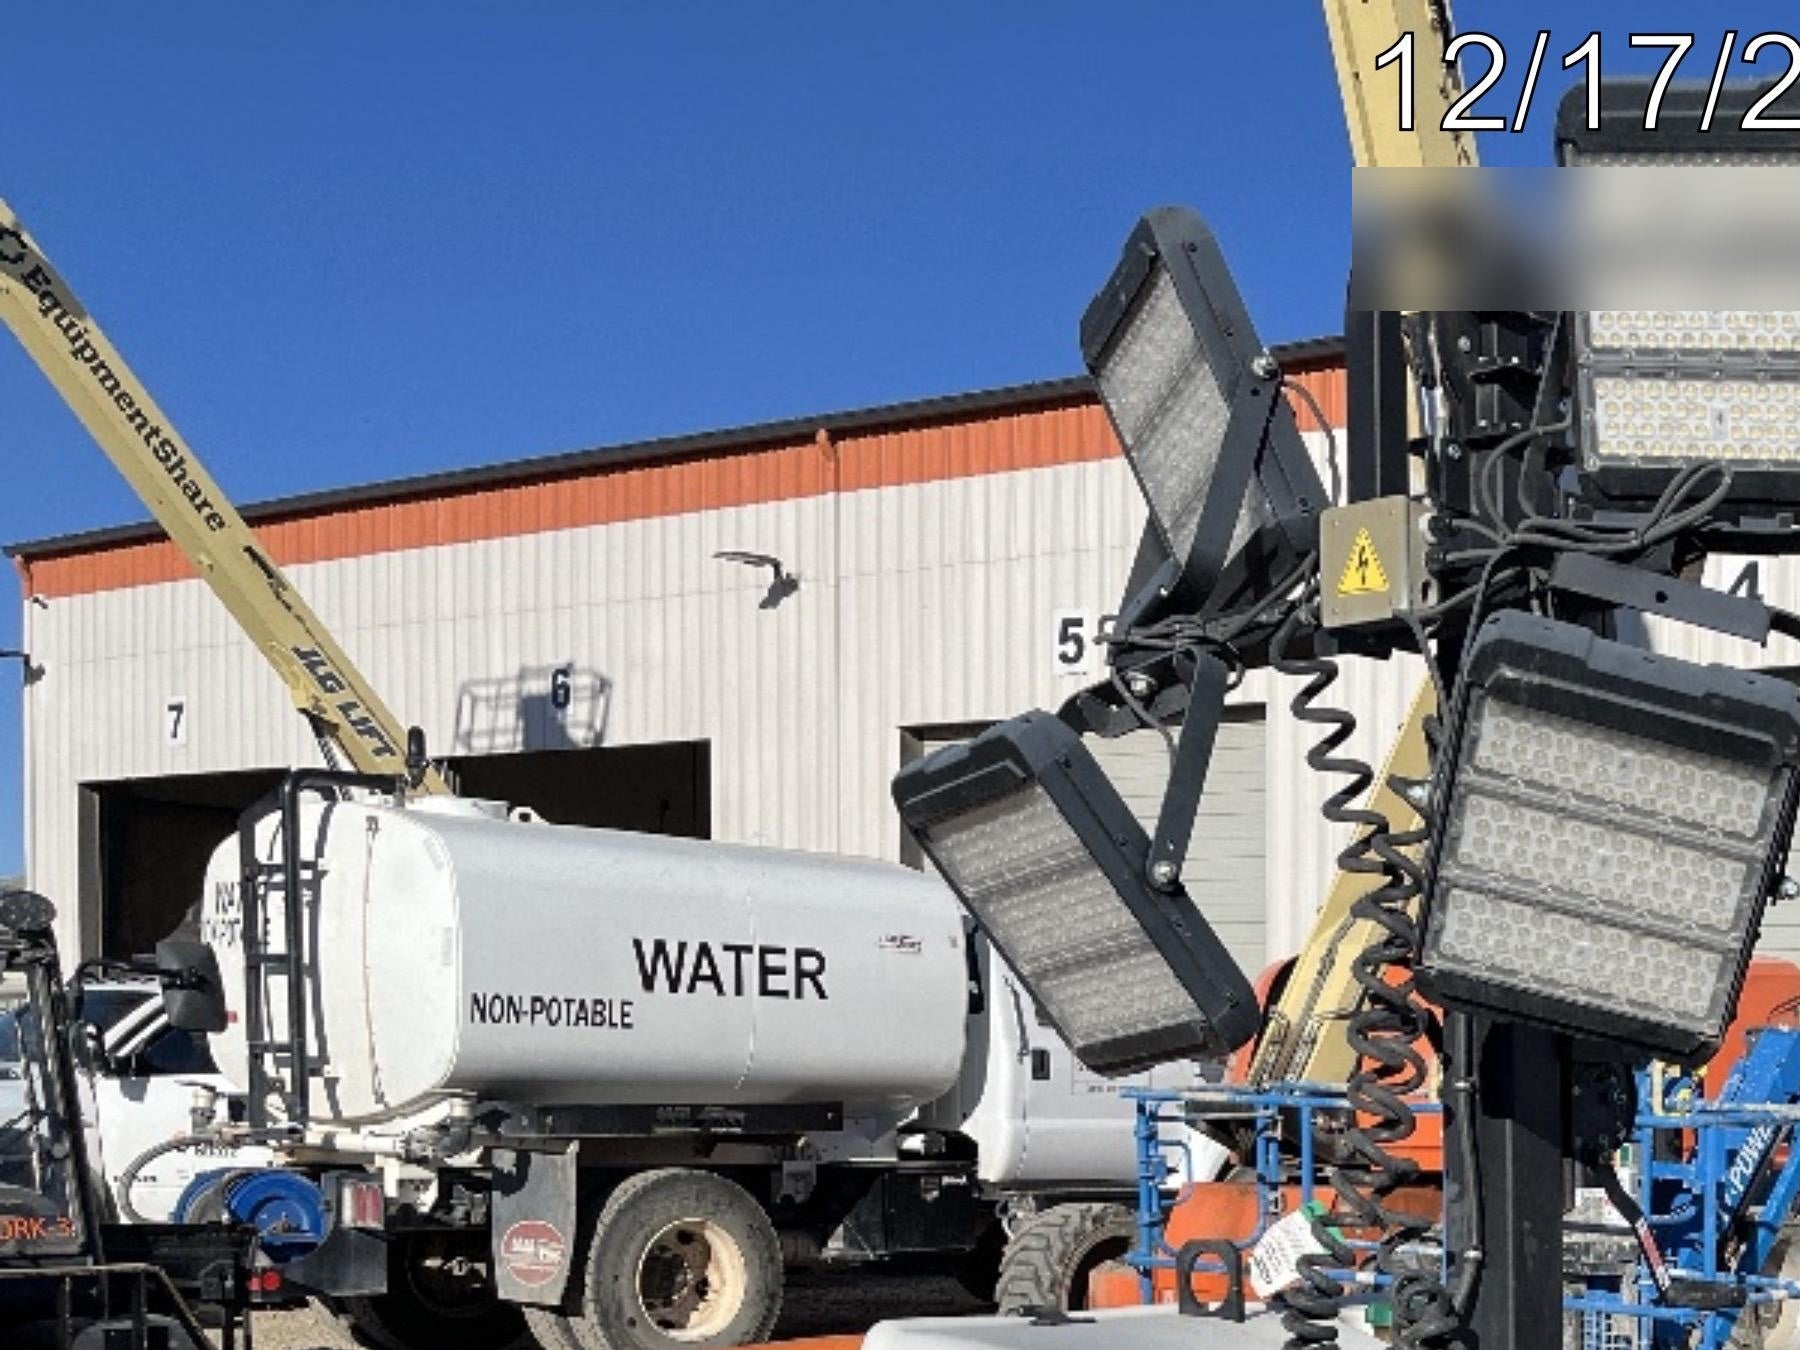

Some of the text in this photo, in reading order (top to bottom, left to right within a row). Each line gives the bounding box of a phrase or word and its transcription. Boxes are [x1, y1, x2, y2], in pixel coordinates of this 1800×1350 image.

[21, 264, 226, 532] EquipmentShare
[1728, 560, 1765, 600] 4
[1058, 617, 1084, 664] 5
[291, 646, 397, 756] JLG LIFT
[551, 668, 571, 710] 6
[167, 701, 184, 739] 7
[632, 937, 829, 1000] WATER
[470, 992, 634, 1030] NON-POTABLE
